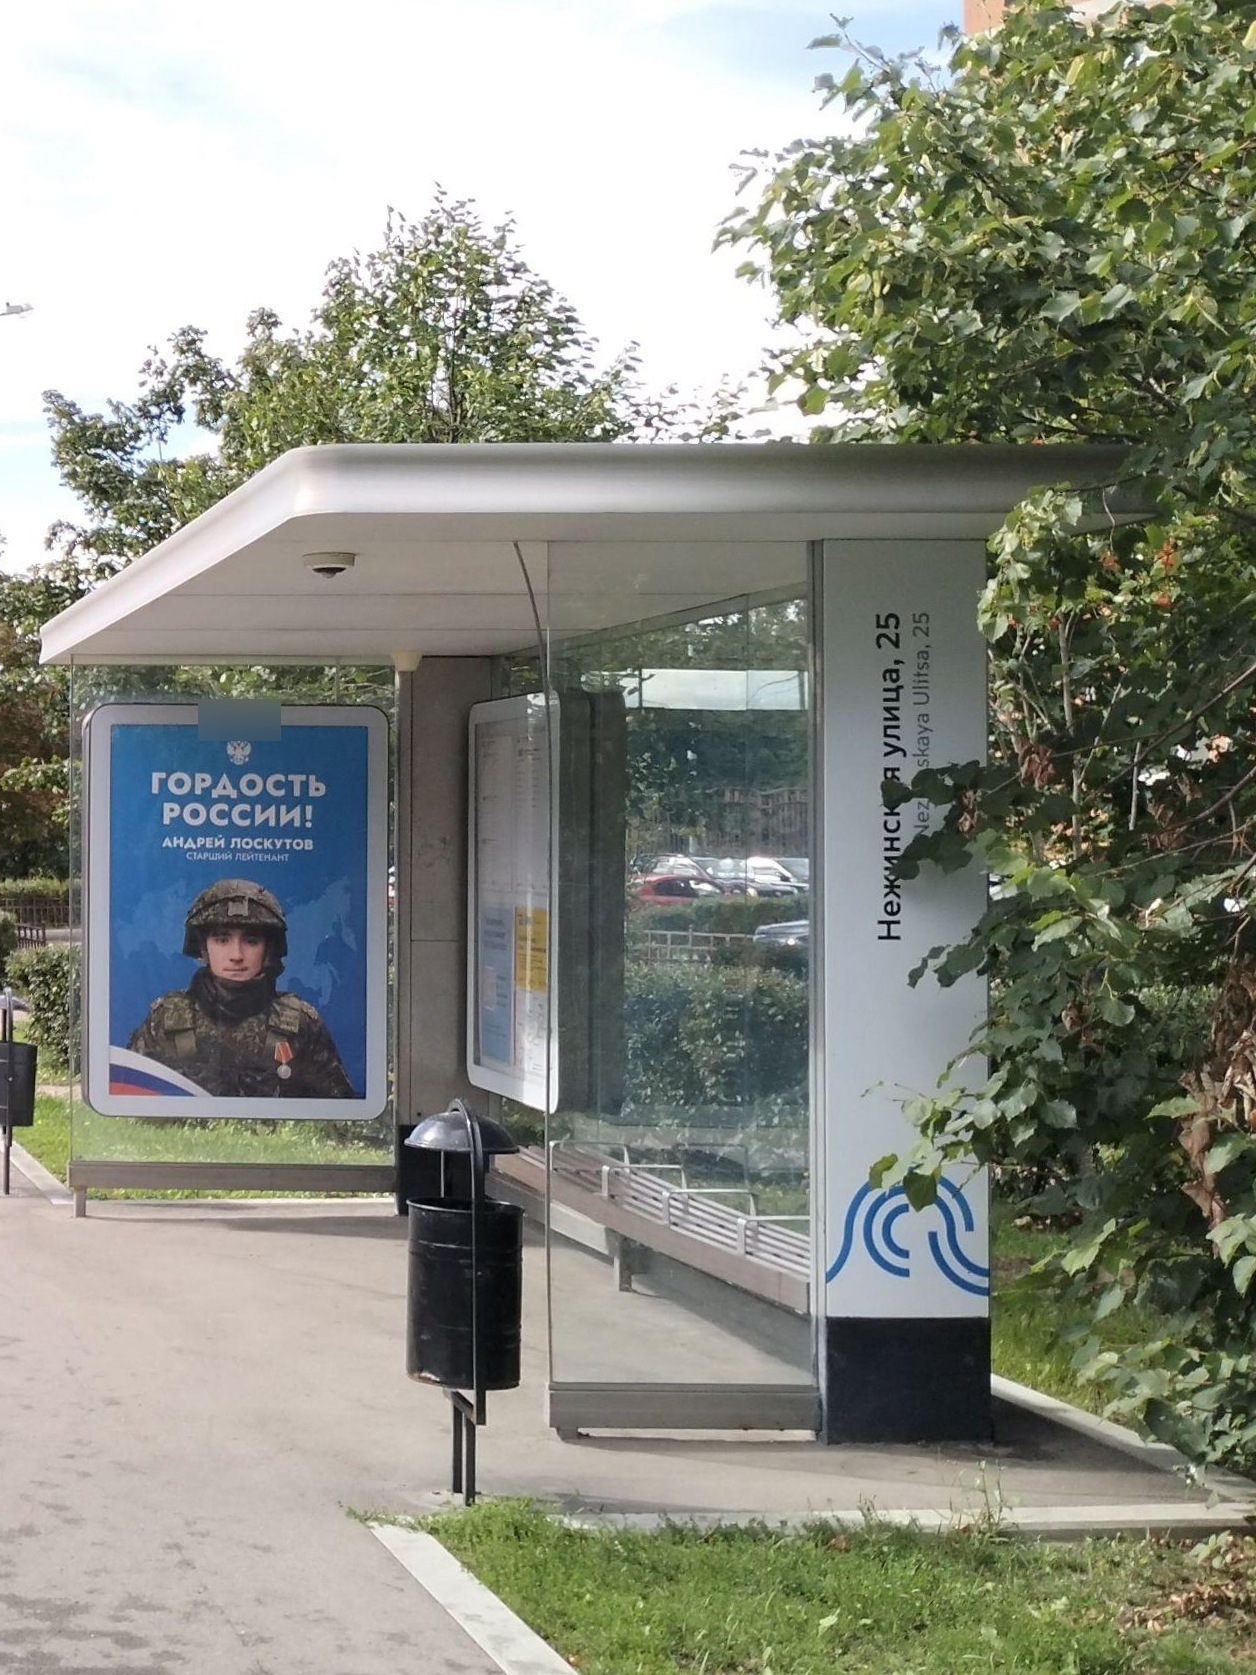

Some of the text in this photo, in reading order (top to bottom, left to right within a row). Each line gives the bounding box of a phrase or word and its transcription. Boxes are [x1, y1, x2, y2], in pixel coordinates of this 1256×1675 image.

[912, 612, 933, 836] Nezskaya Ulitsa, 25
[151, 771, 326, 799] ГОРДОСТЬ
[875, 612, 906, 940] Нежинскя улица, 25
[162, 802, 313, 828] РОССИИ!
[162, 835, 313, 850] АНДРЕЙ ЛОСКУТОВ
[186, 850, 289, 862] СТАРШИЙ ЛЕЙТЕНАНТ
